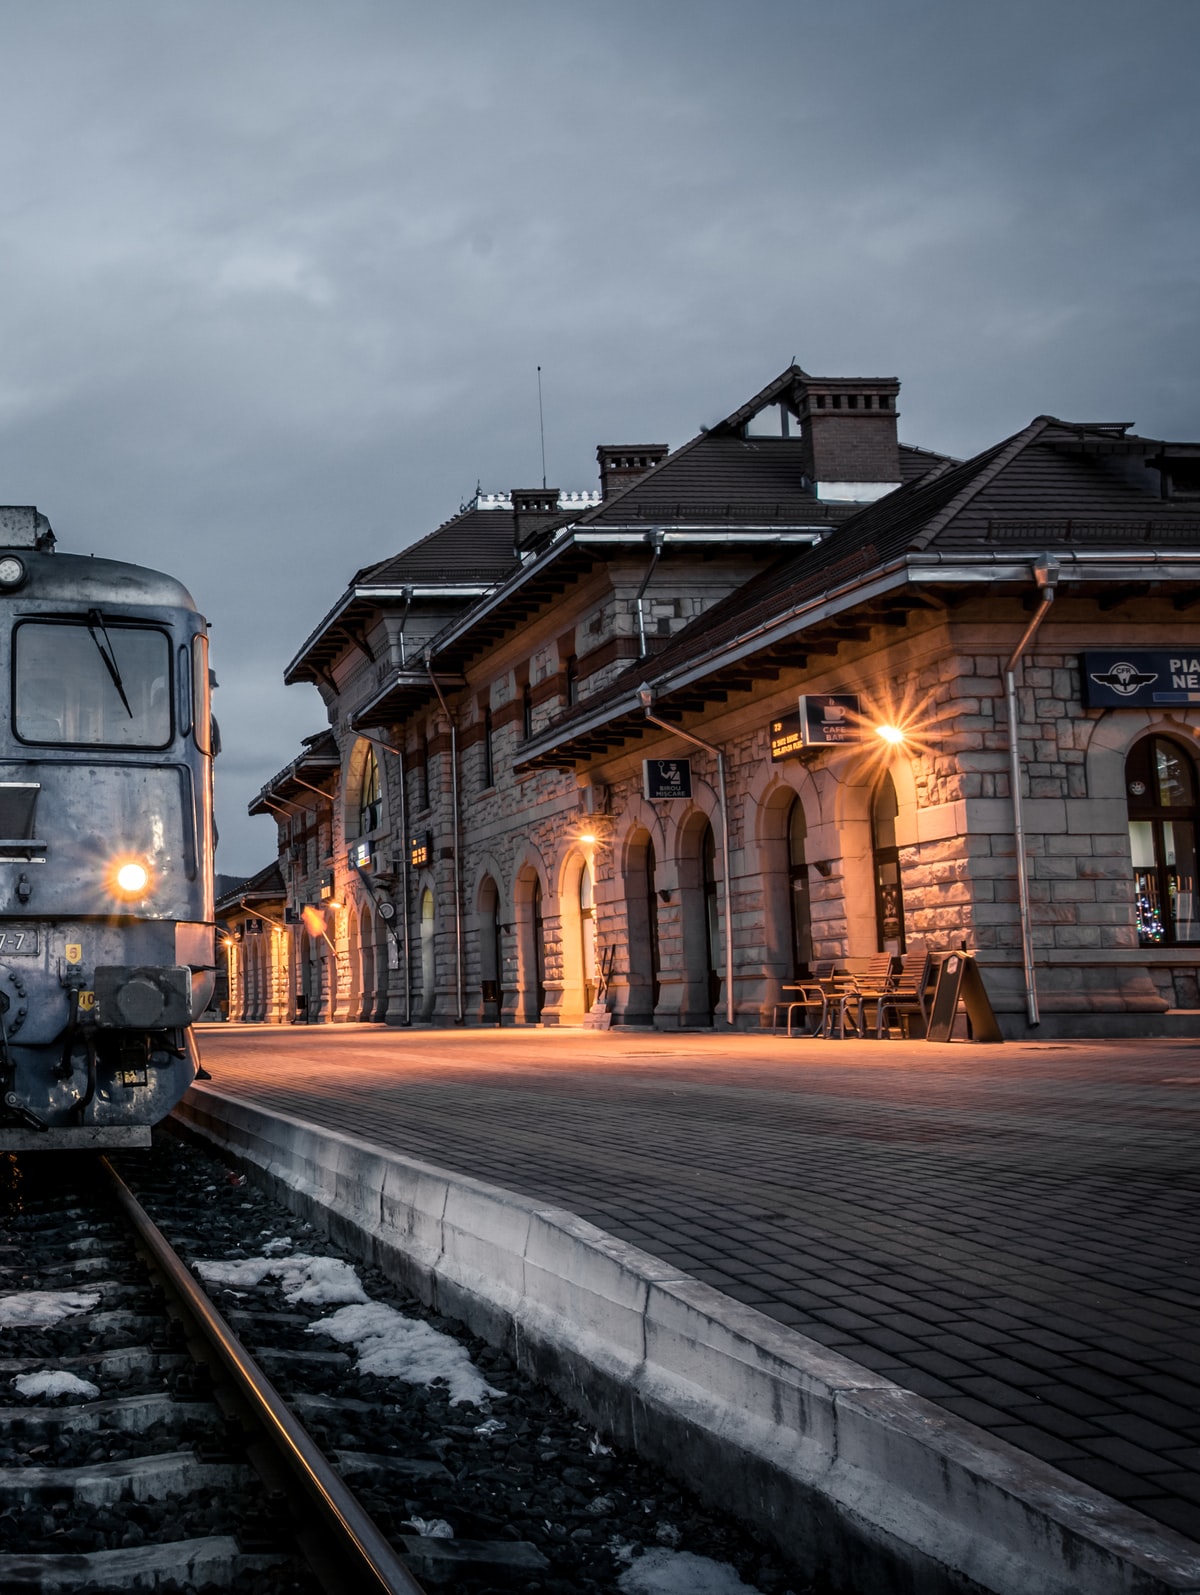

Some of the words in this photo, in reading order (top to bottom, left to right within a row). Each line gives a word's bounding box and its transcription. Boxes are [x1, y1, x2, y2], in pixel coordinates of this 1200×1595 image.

[1172, 674, 1200, 689] NE
[822, 726, 846, 734] CAFE
[825, 734, 845, 742] BAR
[69, 947, 78, 959] 5
[80, 993, 95, 1005] 10
